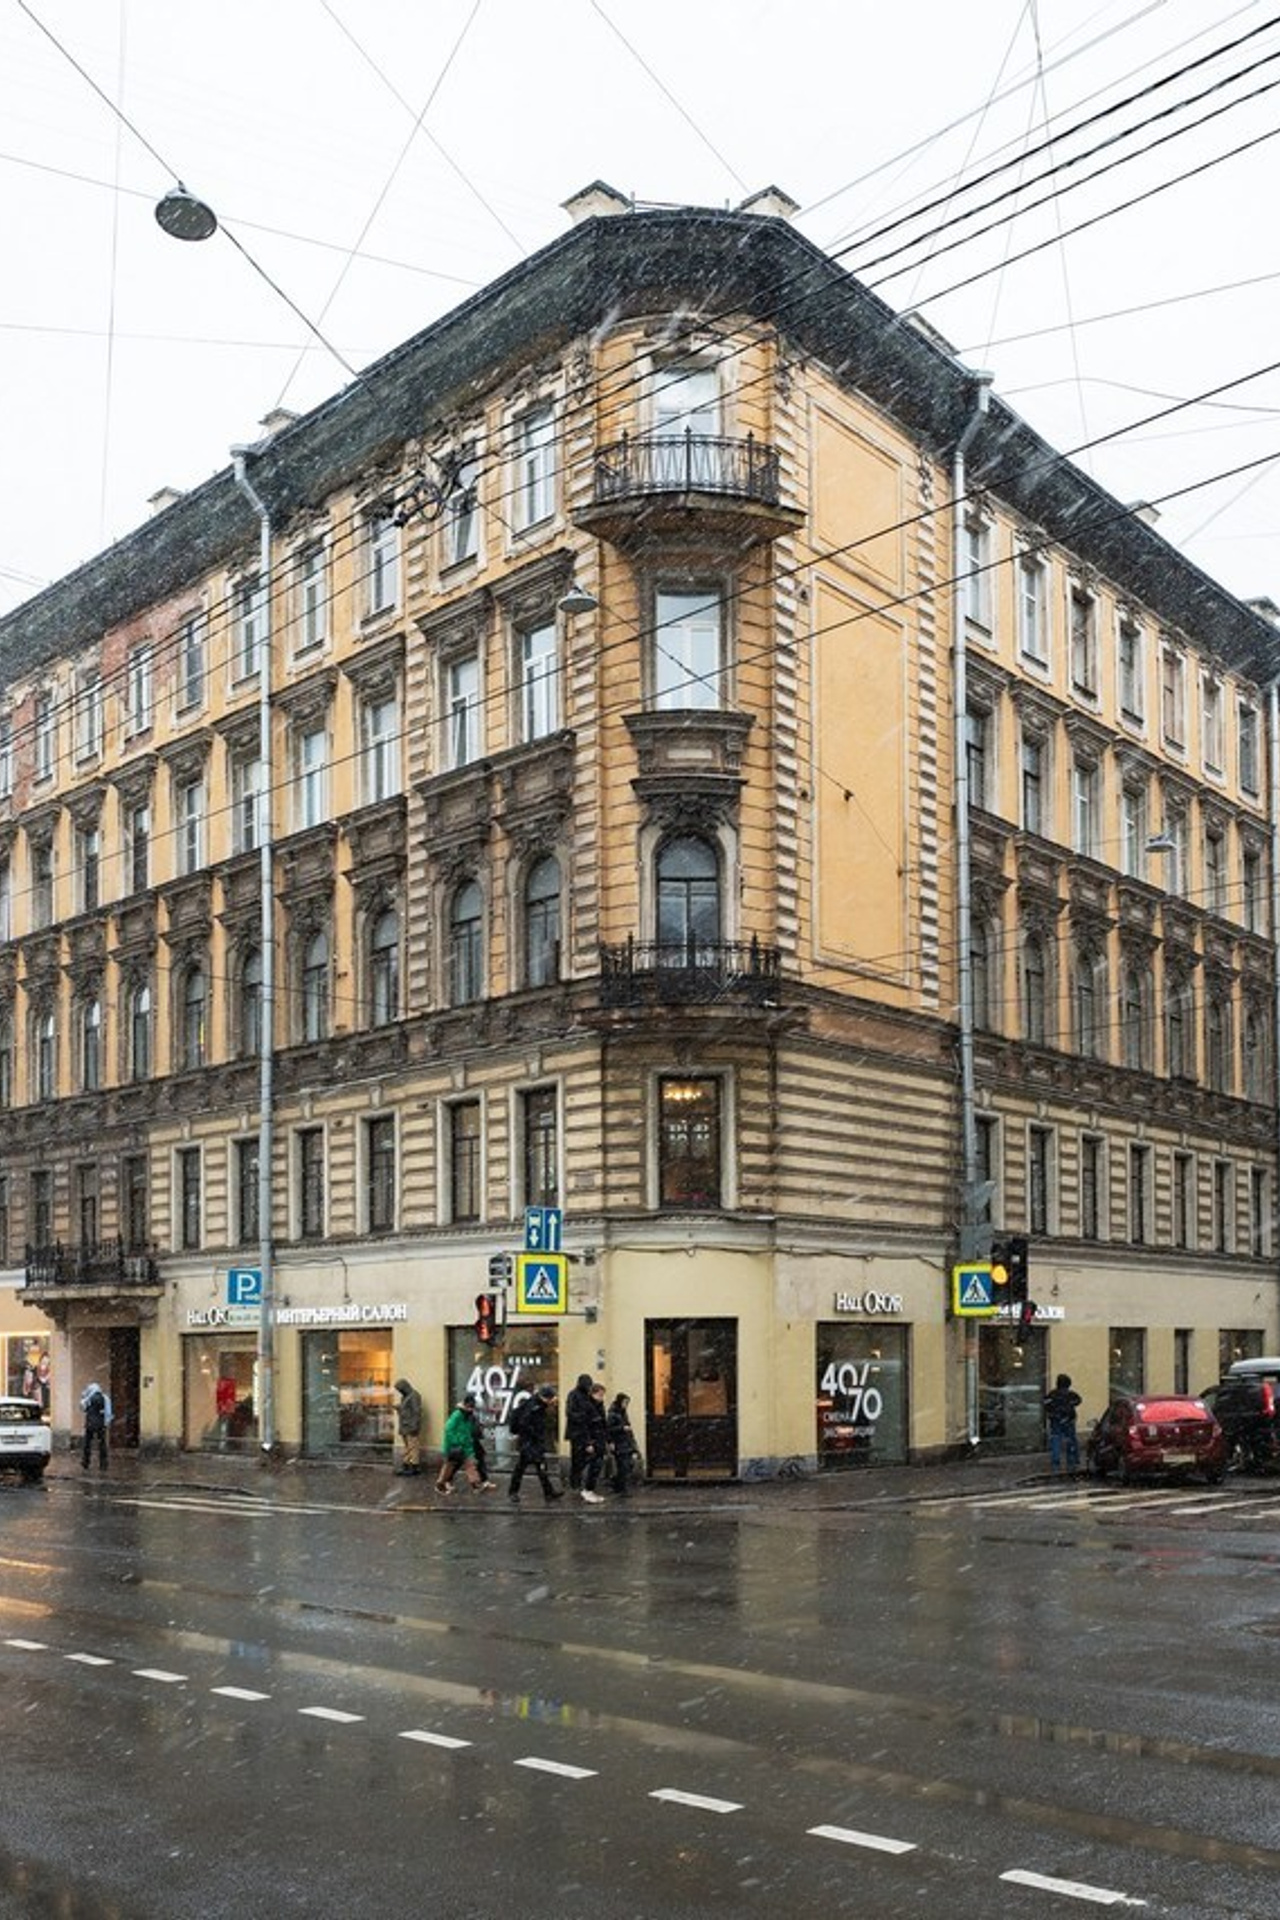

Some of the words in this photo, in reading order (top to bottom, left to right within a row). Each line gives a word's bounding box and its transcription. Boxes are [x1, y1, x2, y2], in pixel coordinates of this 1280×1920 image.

[236, 1274, 256, 1301] P
[362, 1304, 407, 1320] САЛОН
[848, 1387, 883, 1421] 70
